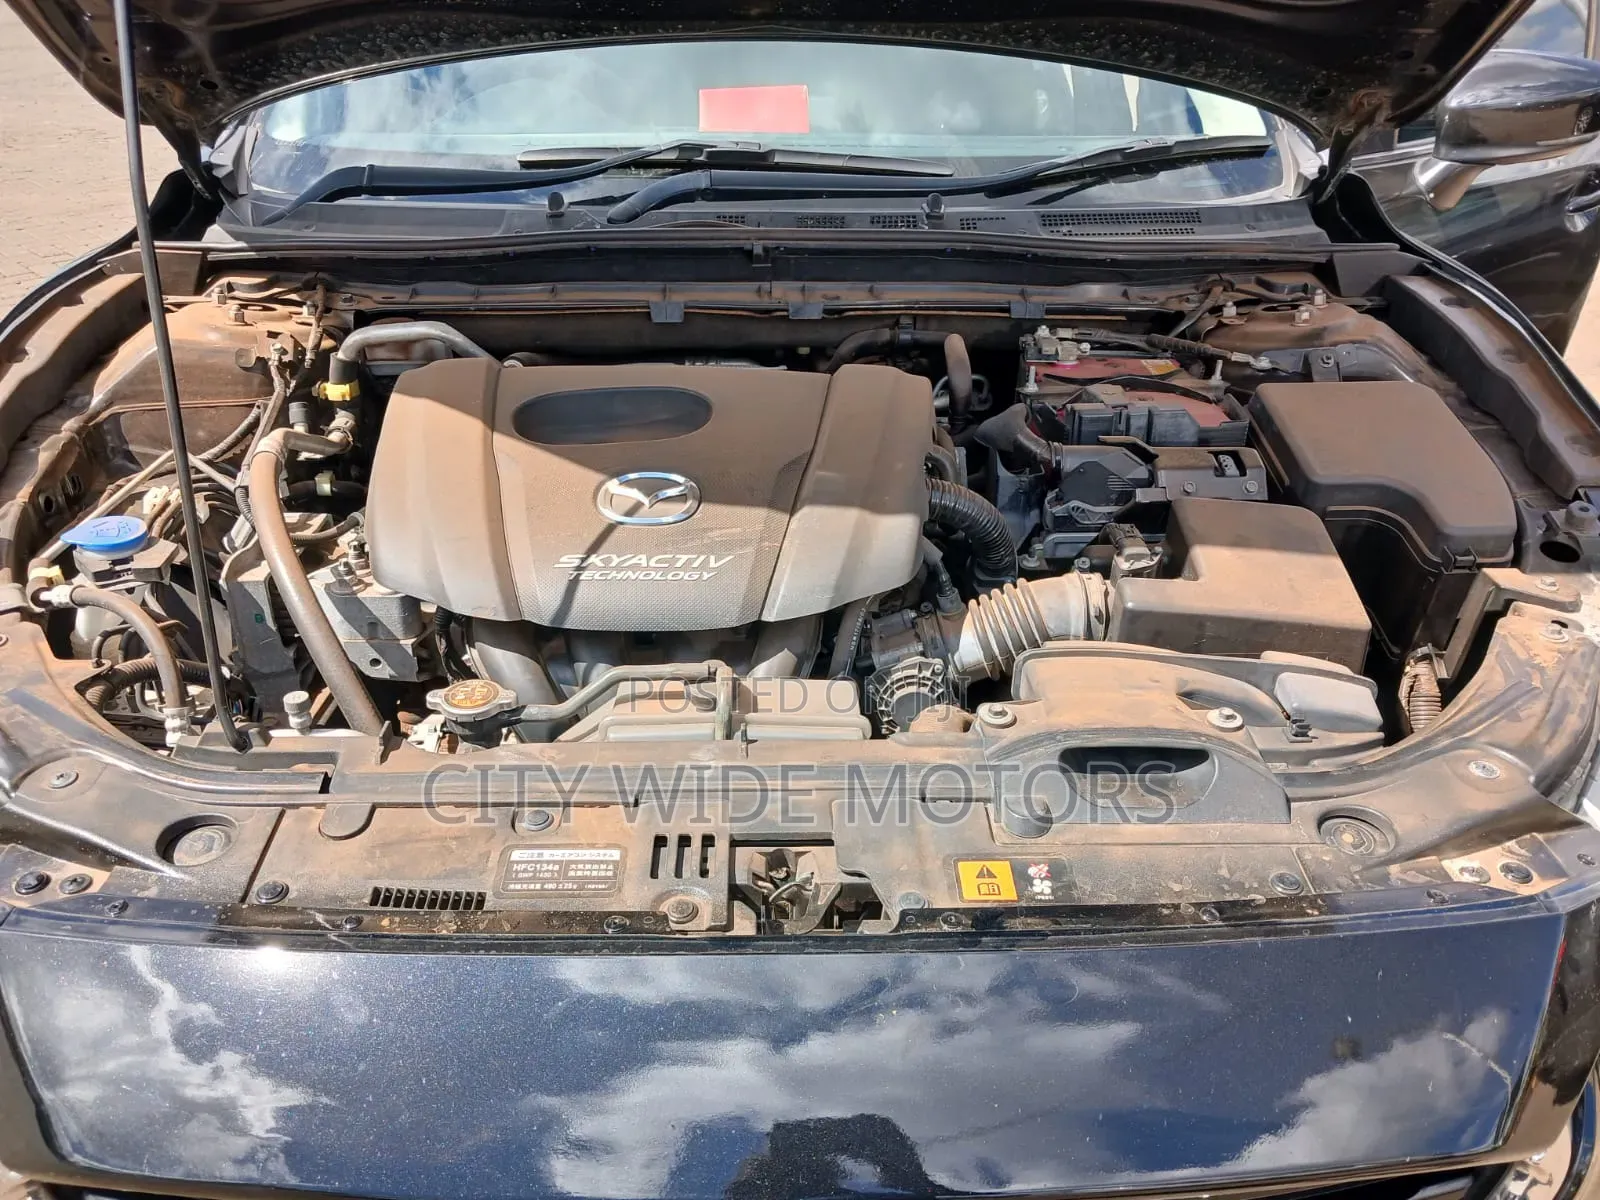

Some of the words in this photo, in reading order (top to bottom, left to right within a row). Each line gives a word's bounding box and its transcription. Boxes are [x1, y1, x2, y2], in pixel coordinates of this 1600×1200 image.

[553, 554, 735, 569] SKYACTIV
[568, 570, 719, 582] TECHNOLOGY
[512, 863, 560, 871] HFC134a
